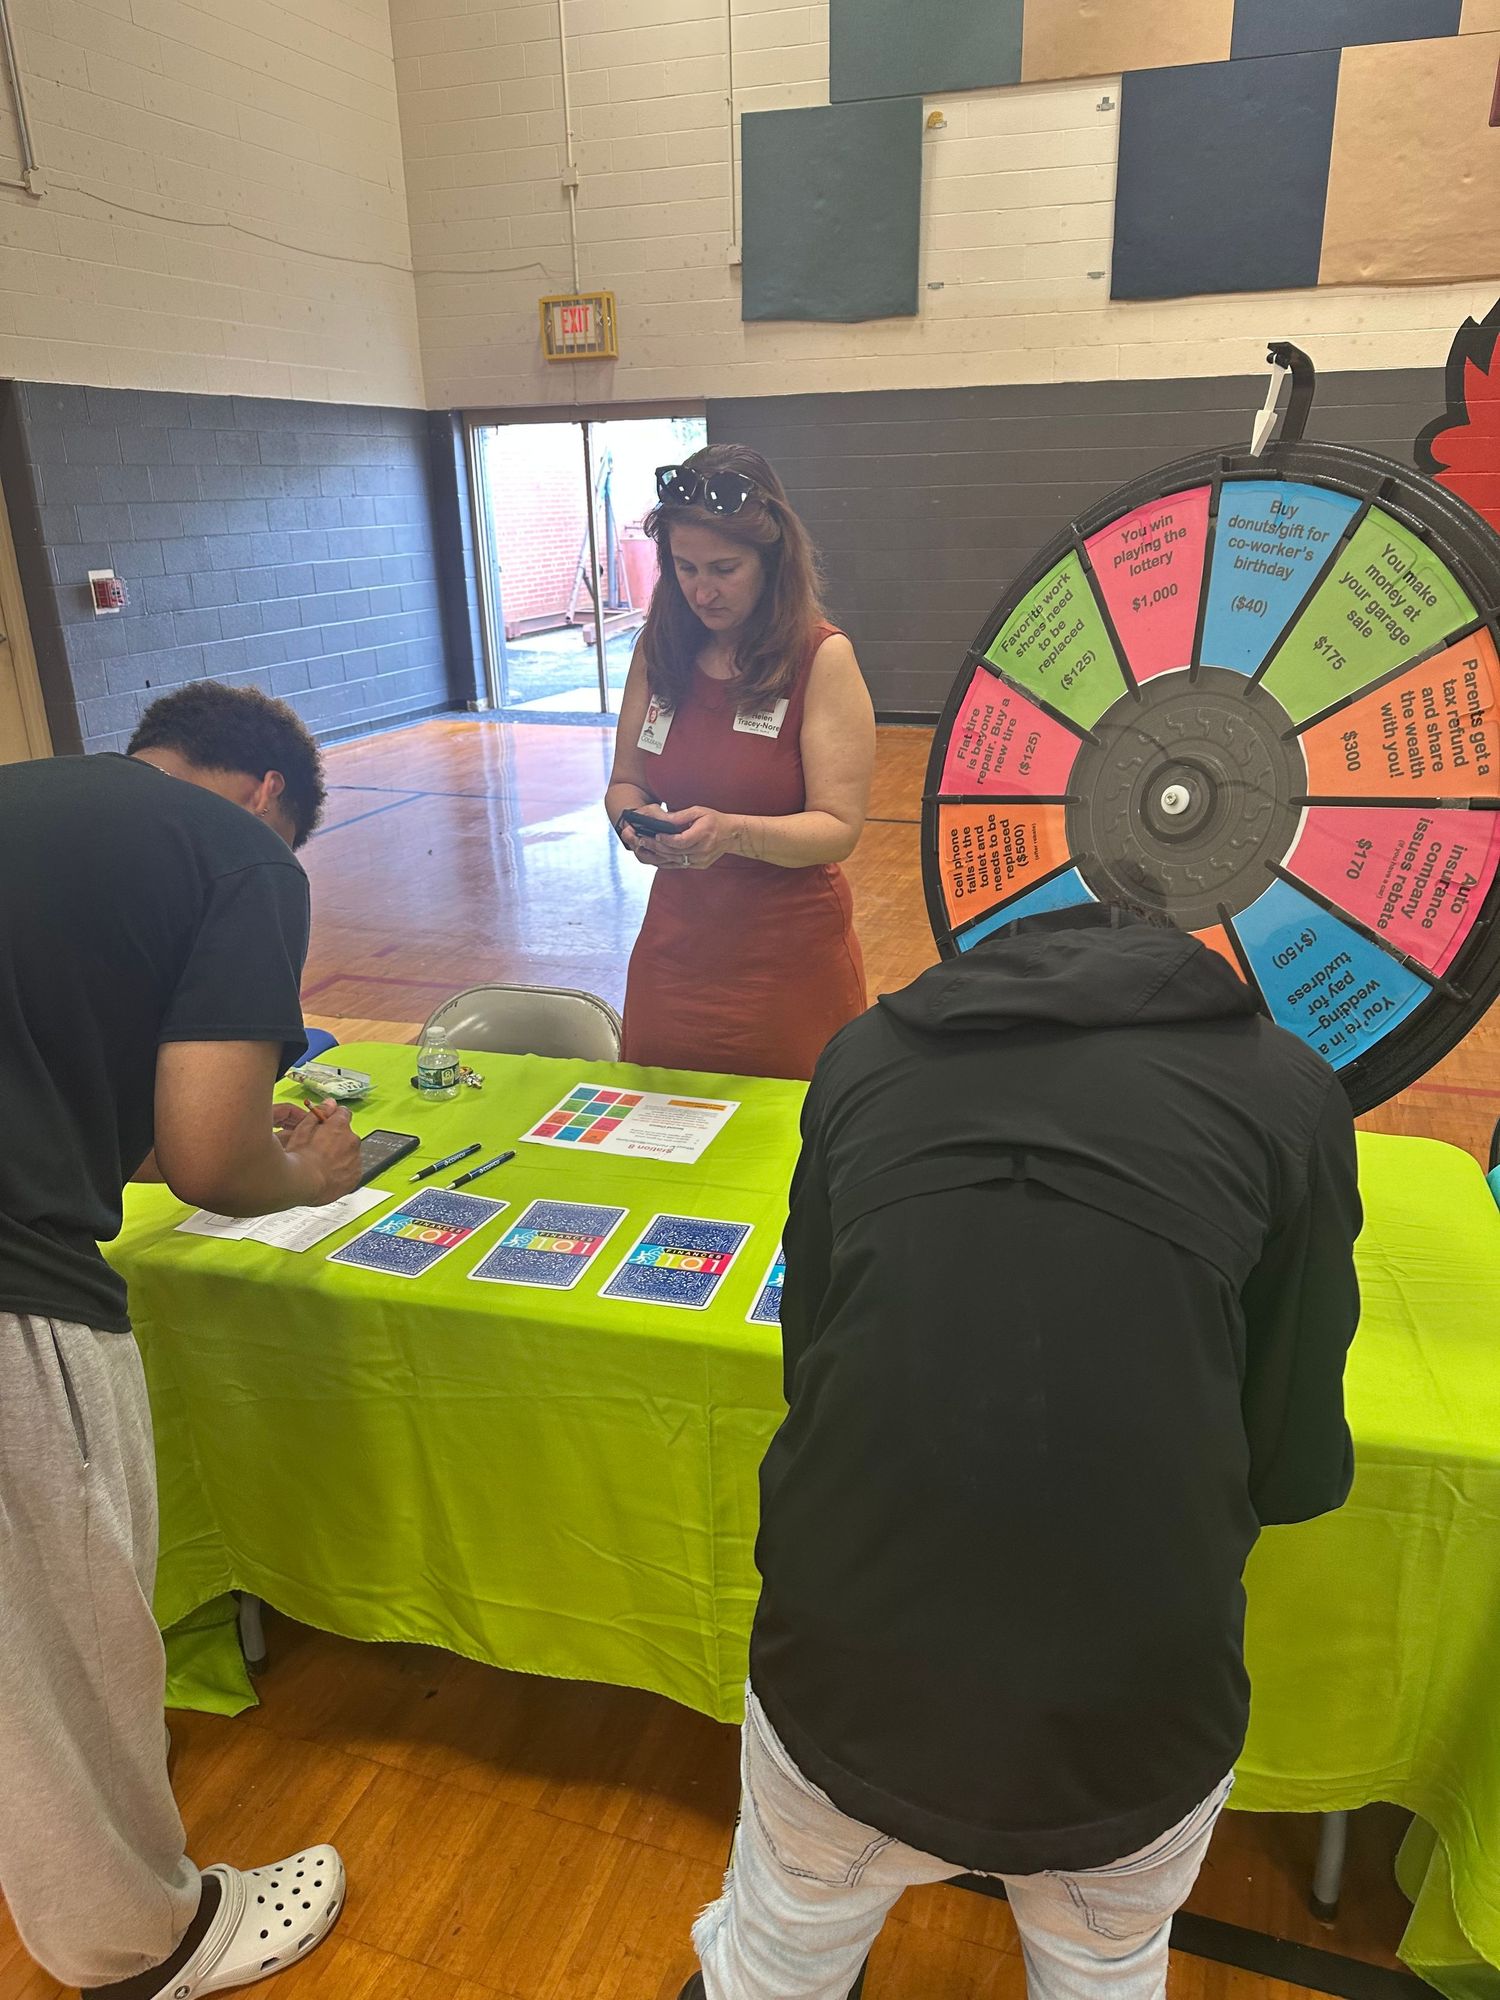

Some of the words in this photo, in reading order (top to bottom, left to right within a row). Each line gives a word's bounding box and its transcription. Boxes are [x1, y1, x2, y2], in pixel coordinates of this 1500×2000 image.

[562, 306, 590, 334] EXIT
[1270, 500, 1299, 518] Buy
[1122, 526, 1147, 544] You
[1149, 514, 1174, 533] win
[1228, 514, 1304, 539] donuts/gift
[1306, 526, 1330, 543] for
[1113, 536, 1162, 568] playing
[1164, 527, 1188, 545] the
[1129, 551, 1174, 577] lottery
[1227, 537, 1315, 562] co-worker's
[1233, 555, 1295, 581] birthday
[1380, 543, 1407, 575] You
[1402, 570, 1438, 608] make
[1132, 583, 1179, 613] $1,000
[1231, 596, 1268, 617] ($40)
[1338, 571, 1371, 606] your
[1365, 599, 1411, 646] garage
[1365, 563, 1407, 609] money
[1402, 605, 1422, 623] at
[1000, 603, 1044, 654] Favorite
[1043, 572, 1071, 605] work
[1016, 622, 1047, 658] shoes
[1046, 590, 1074, 622] need
[1346, 609, 1374, 639] sale
[1037, 619, 1085, 674] replaced
[1038, 635, 1050, 651] to
[1049, 620, 1067, 639] be
[1312, 635, 1347, 671] $175
[1060, 650, 1097, 691] ($125)
[1400, 690, 1416, 719] the
[1421, 687, 1440, 720] and
[1443, 678, 1457, 707] tax
[1462, 658, 1485, 728] Parents
[957, 734, 972, 760] Flat
[967, 708, 981, 732] tire
[971, 704, 995, 757] beyond
[1380, 702, 1398, 739] with
[976, 740, 998, 785] repair.
[990, 709, 1010, 736] Buy
[1002, 697, 1010, 707] a
[993, 745, 1007, 774] new
[1004, 718, 1017, 742] tire
[1018, 731, 1042, 776] ($125)
[1340, 730, 1361, 772] $300
[1405, 722, 1426, 779] wealth
[1426, 722, 1444, 772] share
[1447, 710, 1469, 768] refund
[1469, 732, 1491, 762] get
[967, 758, 978, 770] is
[1382, 741, 1404, 778] you!
[1477, 764, 1490, 776] a
[962, 826, 972, 850] the
[974, 825, 986, 850] and
[988, 814, 996, 832] be
[951, 829, 964, 869] phone
[965, 851, 974, 864] in
[988, 834, 999, 850] to
[999, 819, 1016, 879] replaced
[1014, 823, 1030, 867] ($500)
[1346, 838, 1374, 880] $170
[1400, 817, 1434, 872] issues
[955, 869, 964, 898] Cell
[967, 864, 977, 895] falls
[979, 852, 990, 888] toilet
[990, 853, 1002, 892] needs
[1400, 841, 1442, 920] company
[1421, 844, 1468, 929] insurance
[1376, 874, 1407, 929] rebate
[1450, 872, 1478, 914] Auto
[1272, 928, 1317, 969] ($150)
[1287, 952, 1352, 1005] tux/dress
[1327, 970, 1355, 998] pay
[1308, 995, 1330, 1015] for
[1345, 997, 1396, 1034] You're
[1318, 1043, 1330, 1055] a
[1329, 1032, 1347, 1046] in
[409, 1227, 458, 1247] 101
[412, 1219, 464, 1235] FINANCES
[538, 1232, 595, 1243] FINANCES
[537, 1238, 591, 1255] 101
[664, 1248, 724, 1261] FINANCES
[665, 1255, 722, 1273] 101
